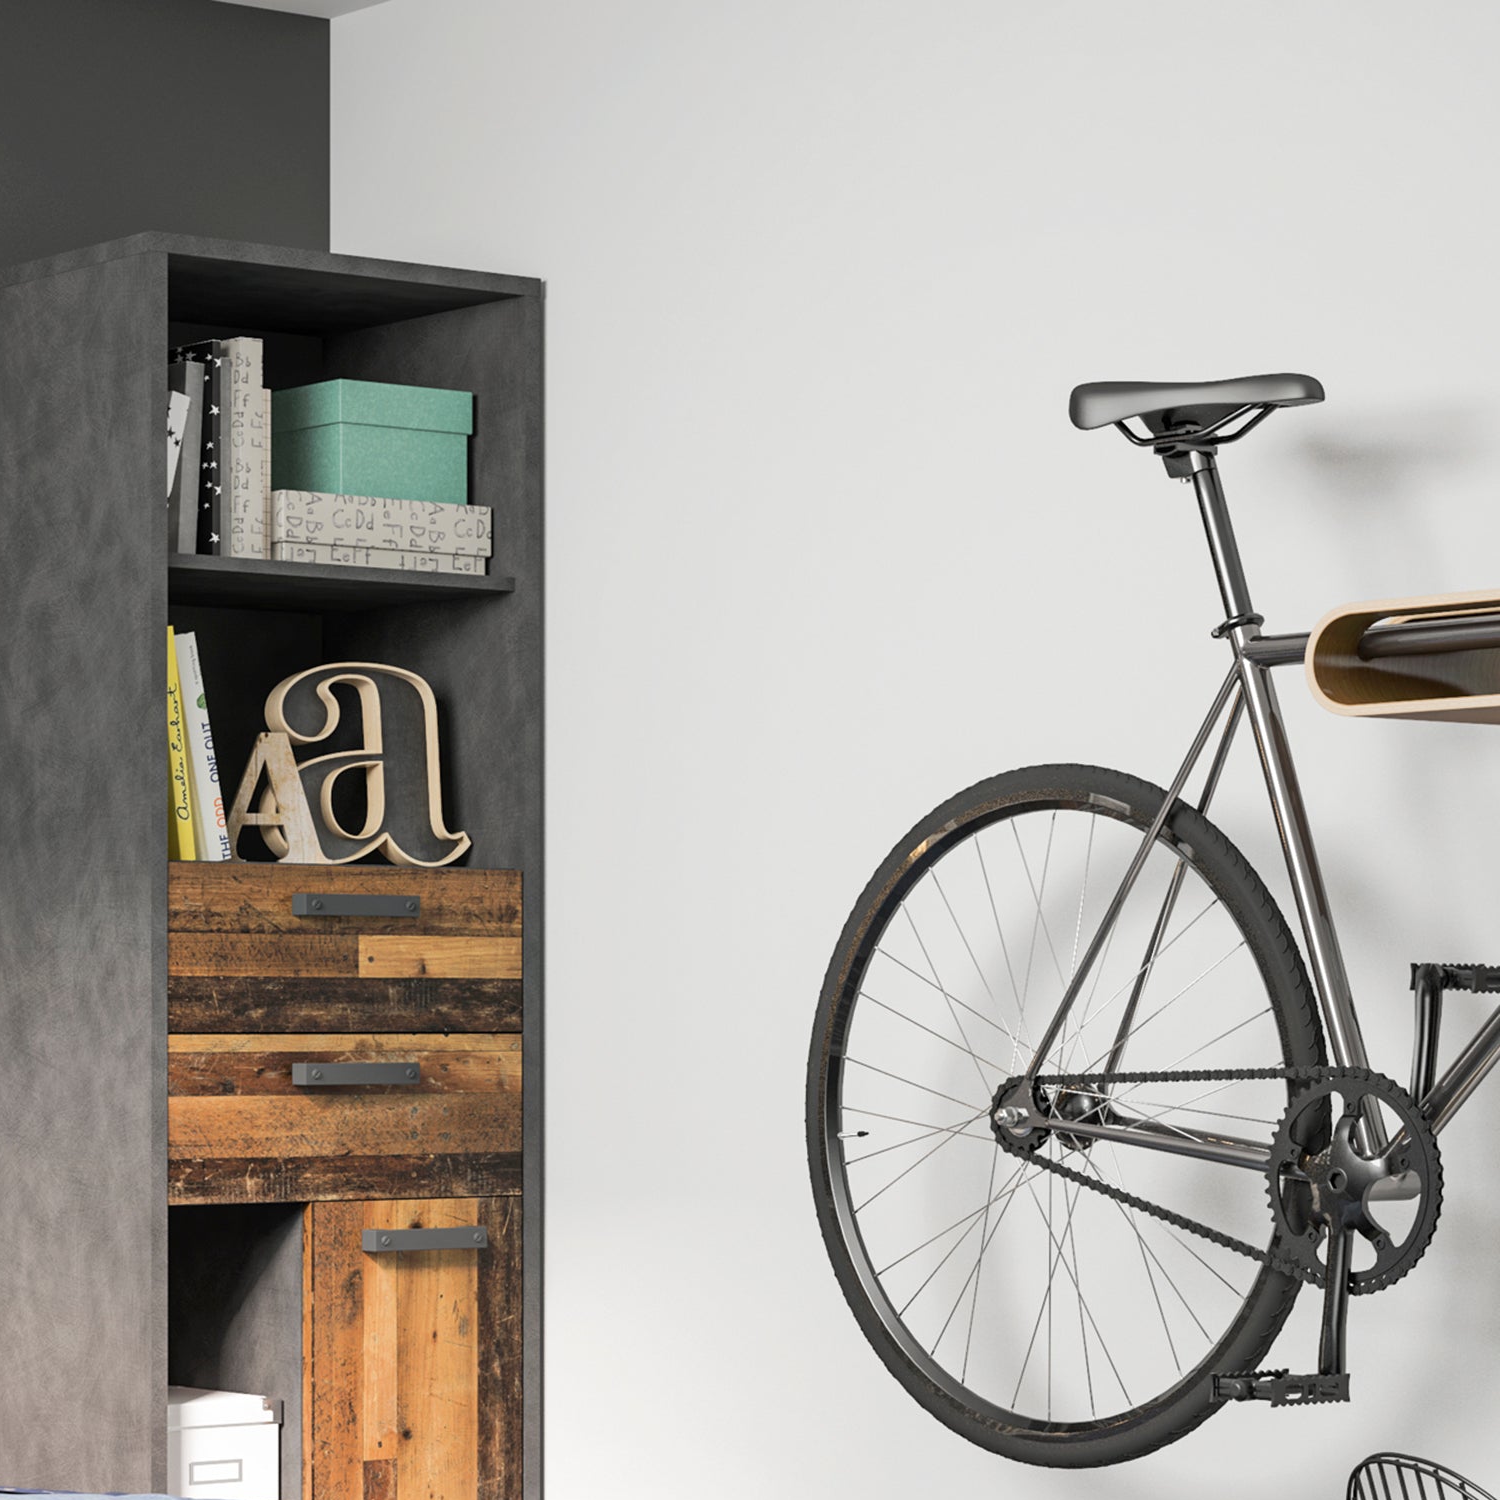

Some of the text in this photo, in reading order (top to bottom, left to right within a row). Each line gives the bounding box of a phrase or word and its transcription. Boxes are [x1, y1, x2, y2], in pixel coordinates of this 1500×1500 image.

[200, 722, 232, 860] THE ODD ONE OUT
